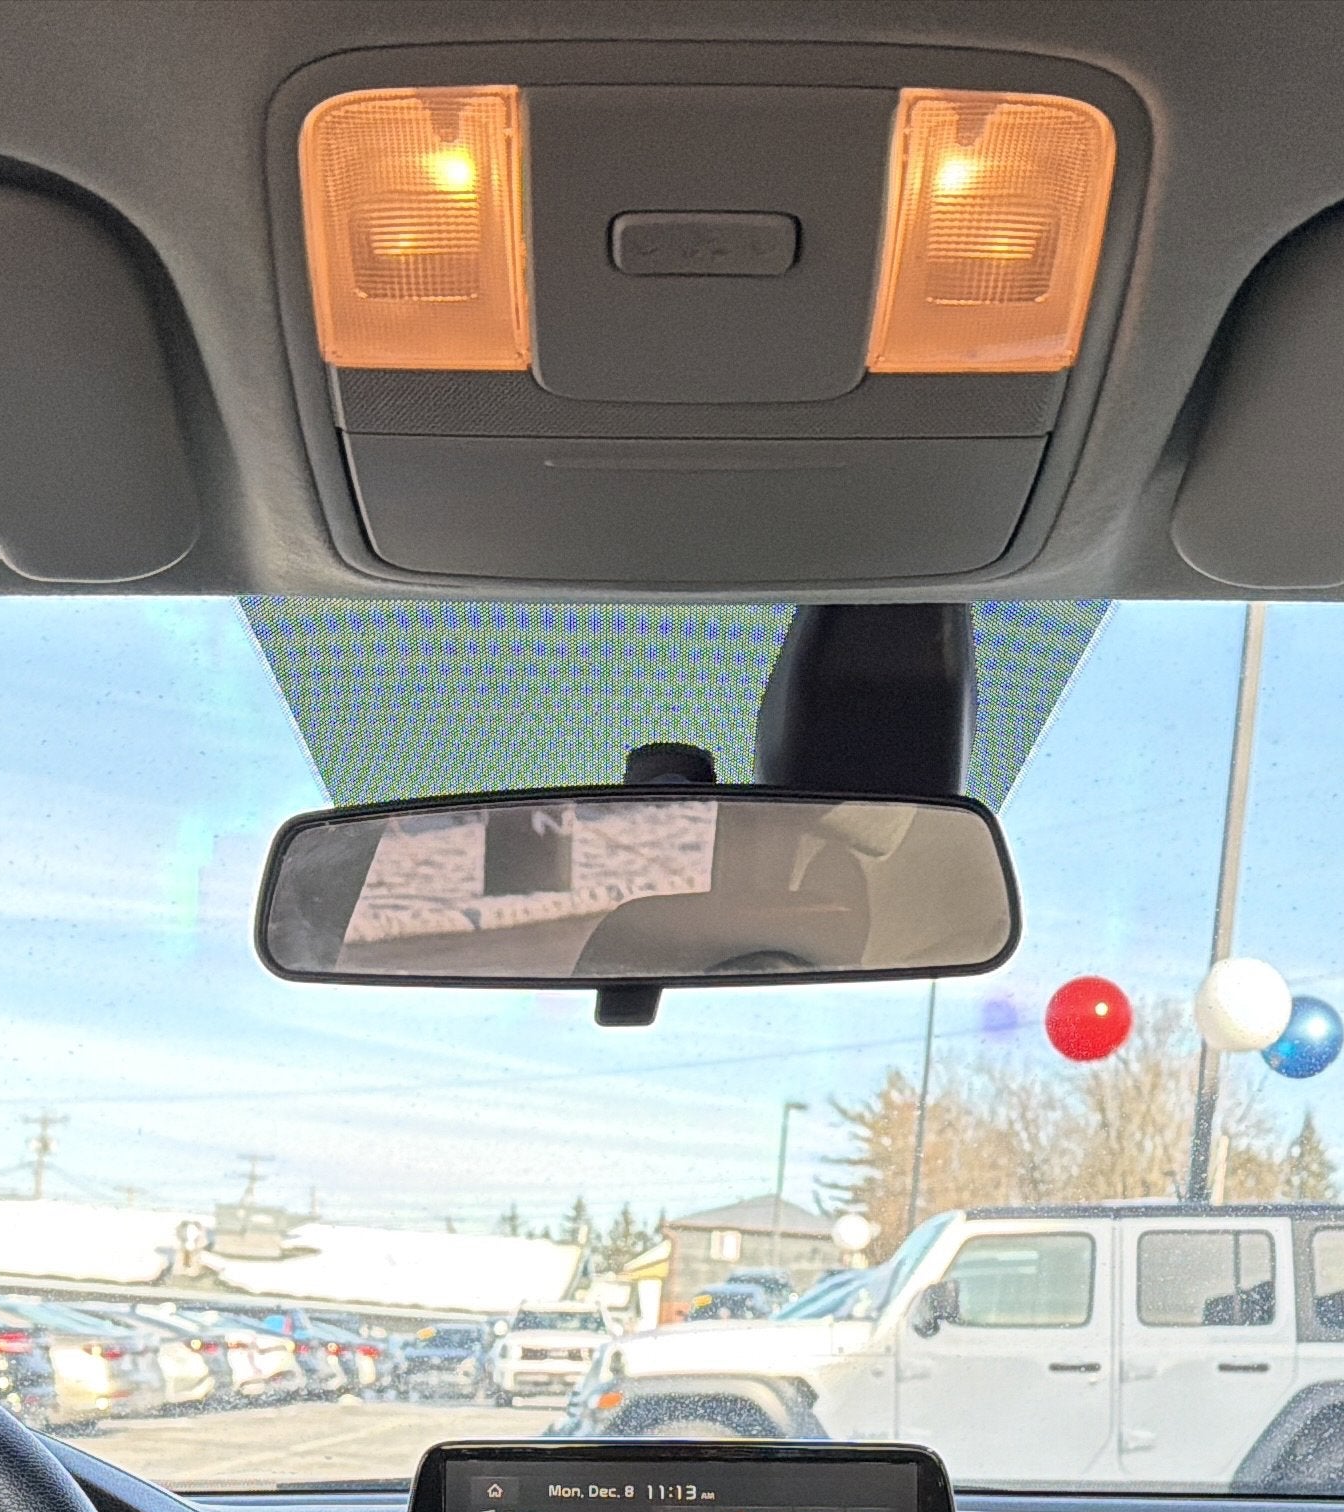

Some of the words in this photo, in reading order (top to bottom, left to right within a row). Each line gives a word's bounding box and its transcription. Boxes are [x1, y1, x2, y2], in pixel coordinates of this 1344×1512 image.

[588, 1485, 621, 1499] Dec.
[624, 1485, 635, 1498] 8
[647, 1485, 698, 1501] 11:13
[700, 1491, 716, 1500] AM
